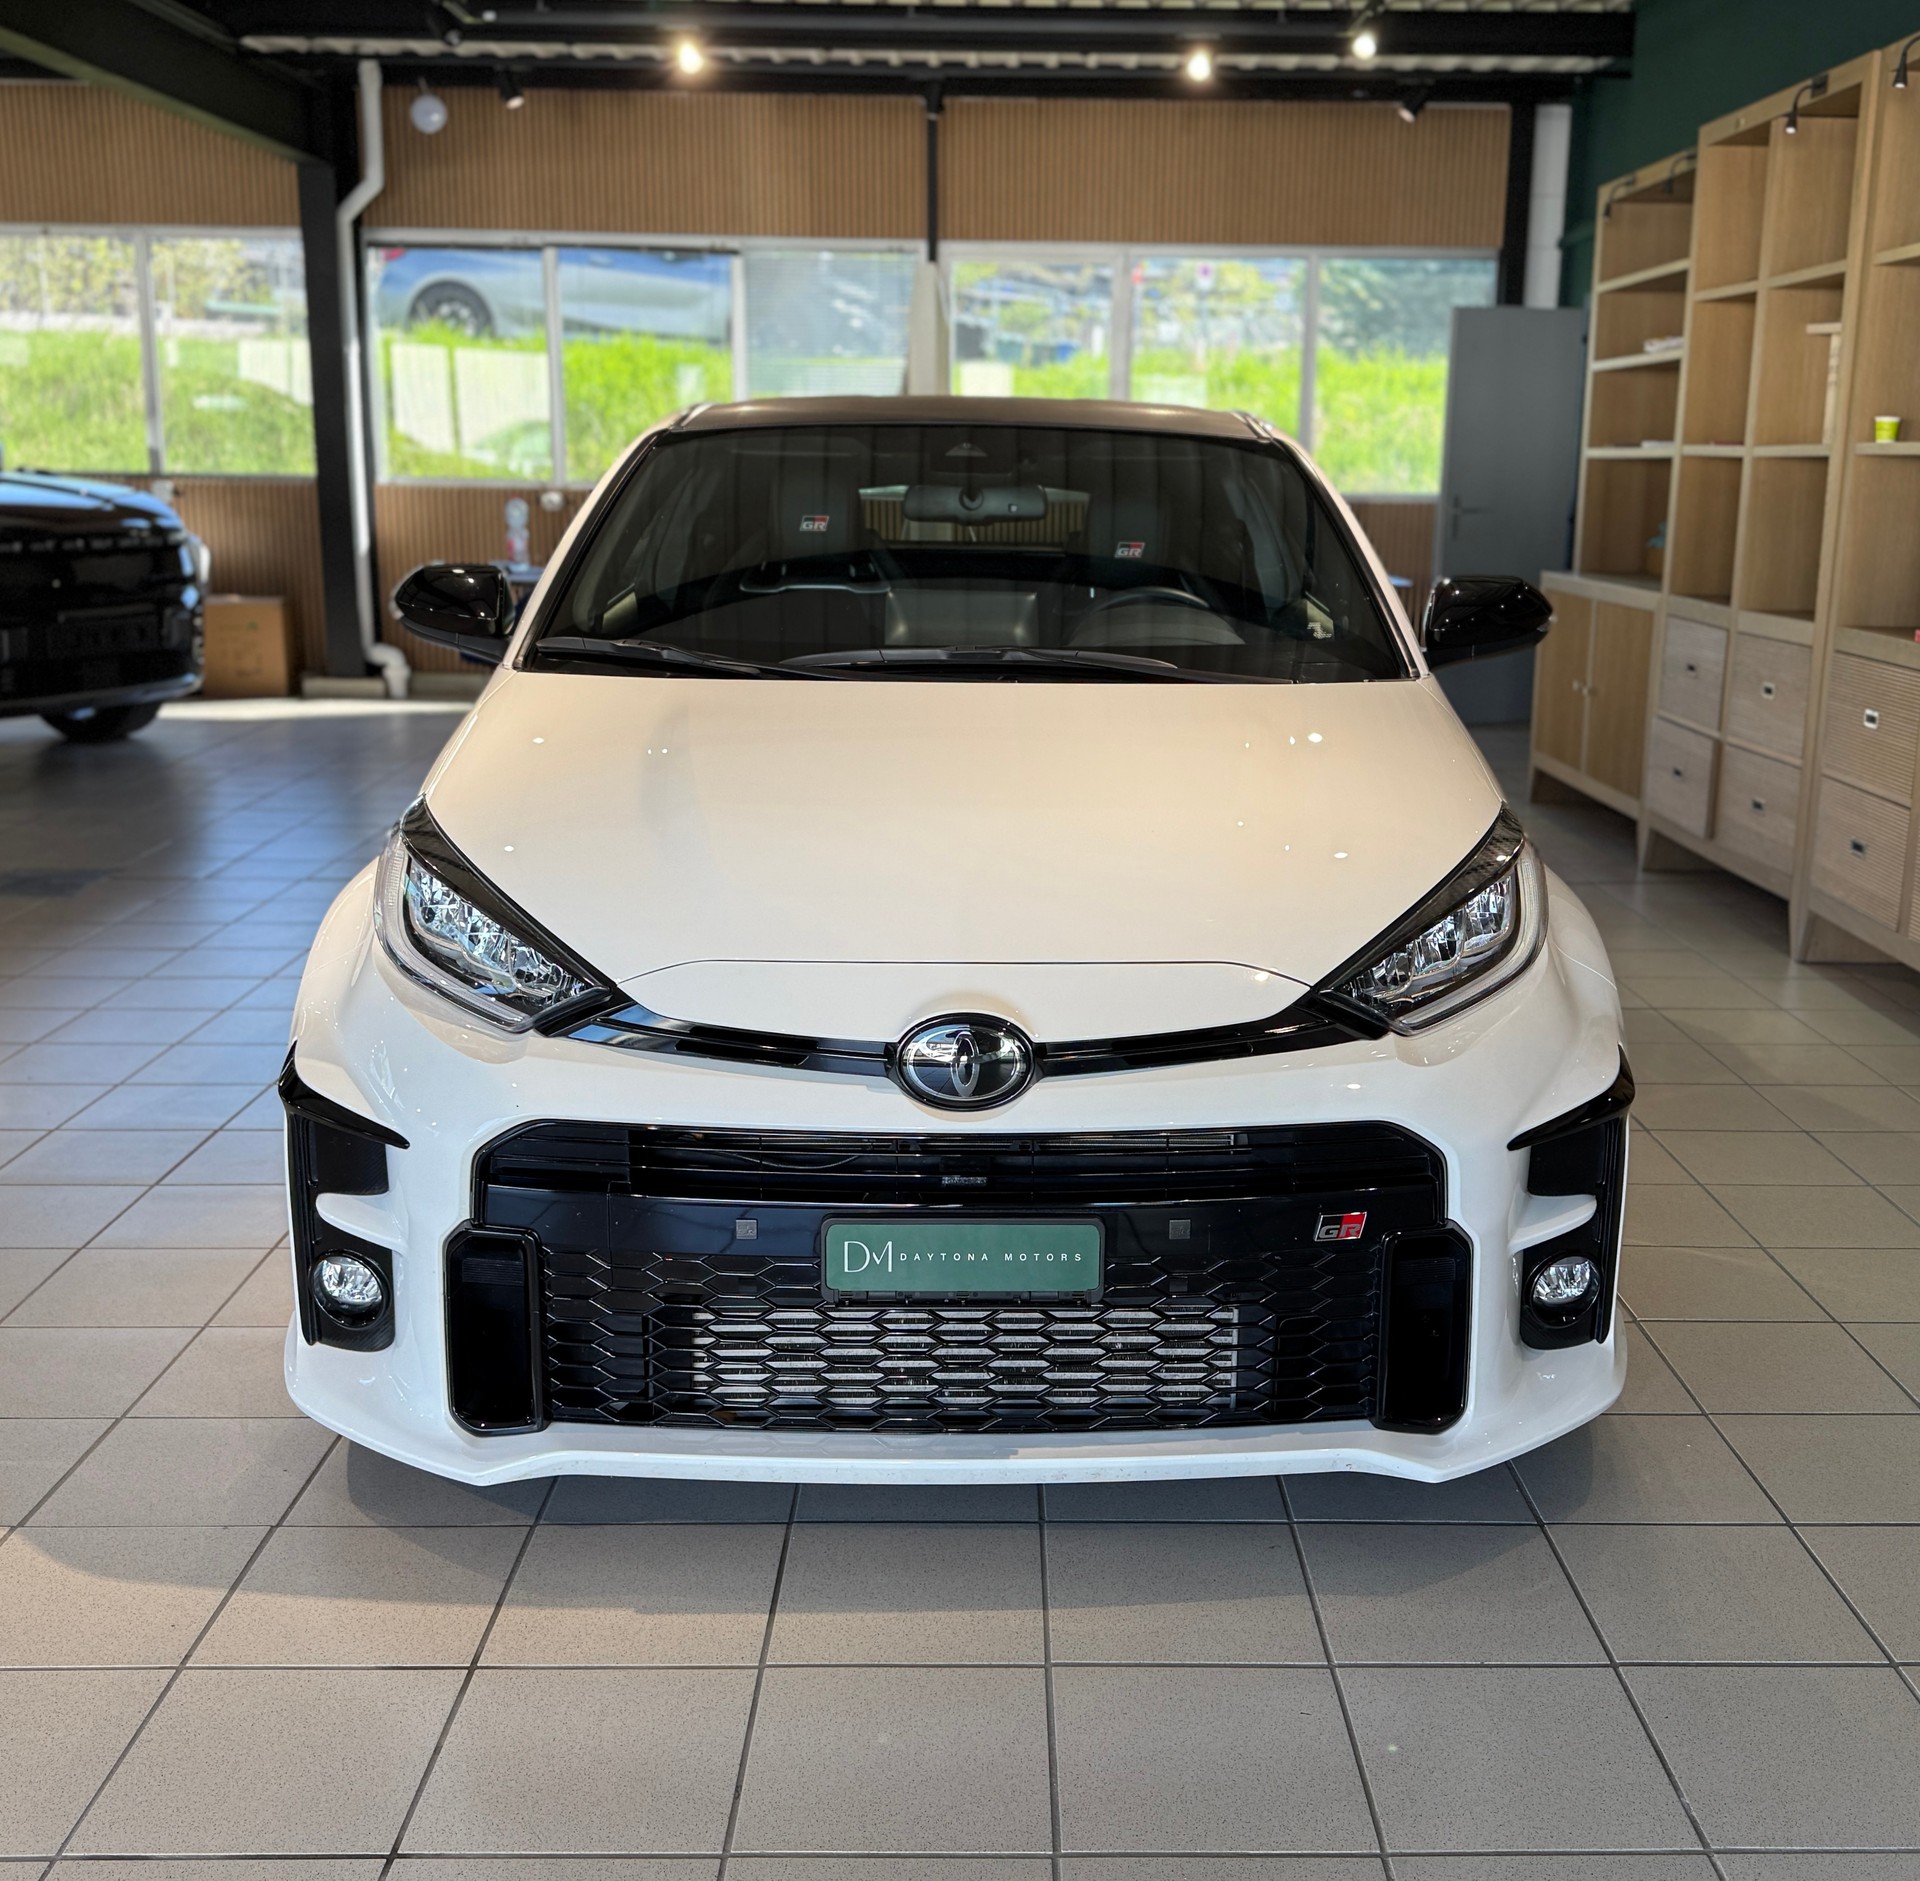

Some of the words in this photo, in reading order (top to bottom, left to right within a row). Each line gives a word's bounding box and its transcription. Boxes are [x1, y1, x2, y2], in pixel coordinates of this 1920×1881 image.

[1318, 1223, 1362, 1239] GR
[844, 1240, 893, 1273] DM
[900, 1253, 988, 1261] DAYTONA
[1004, 1253, 1082, 1261] MOTORS
